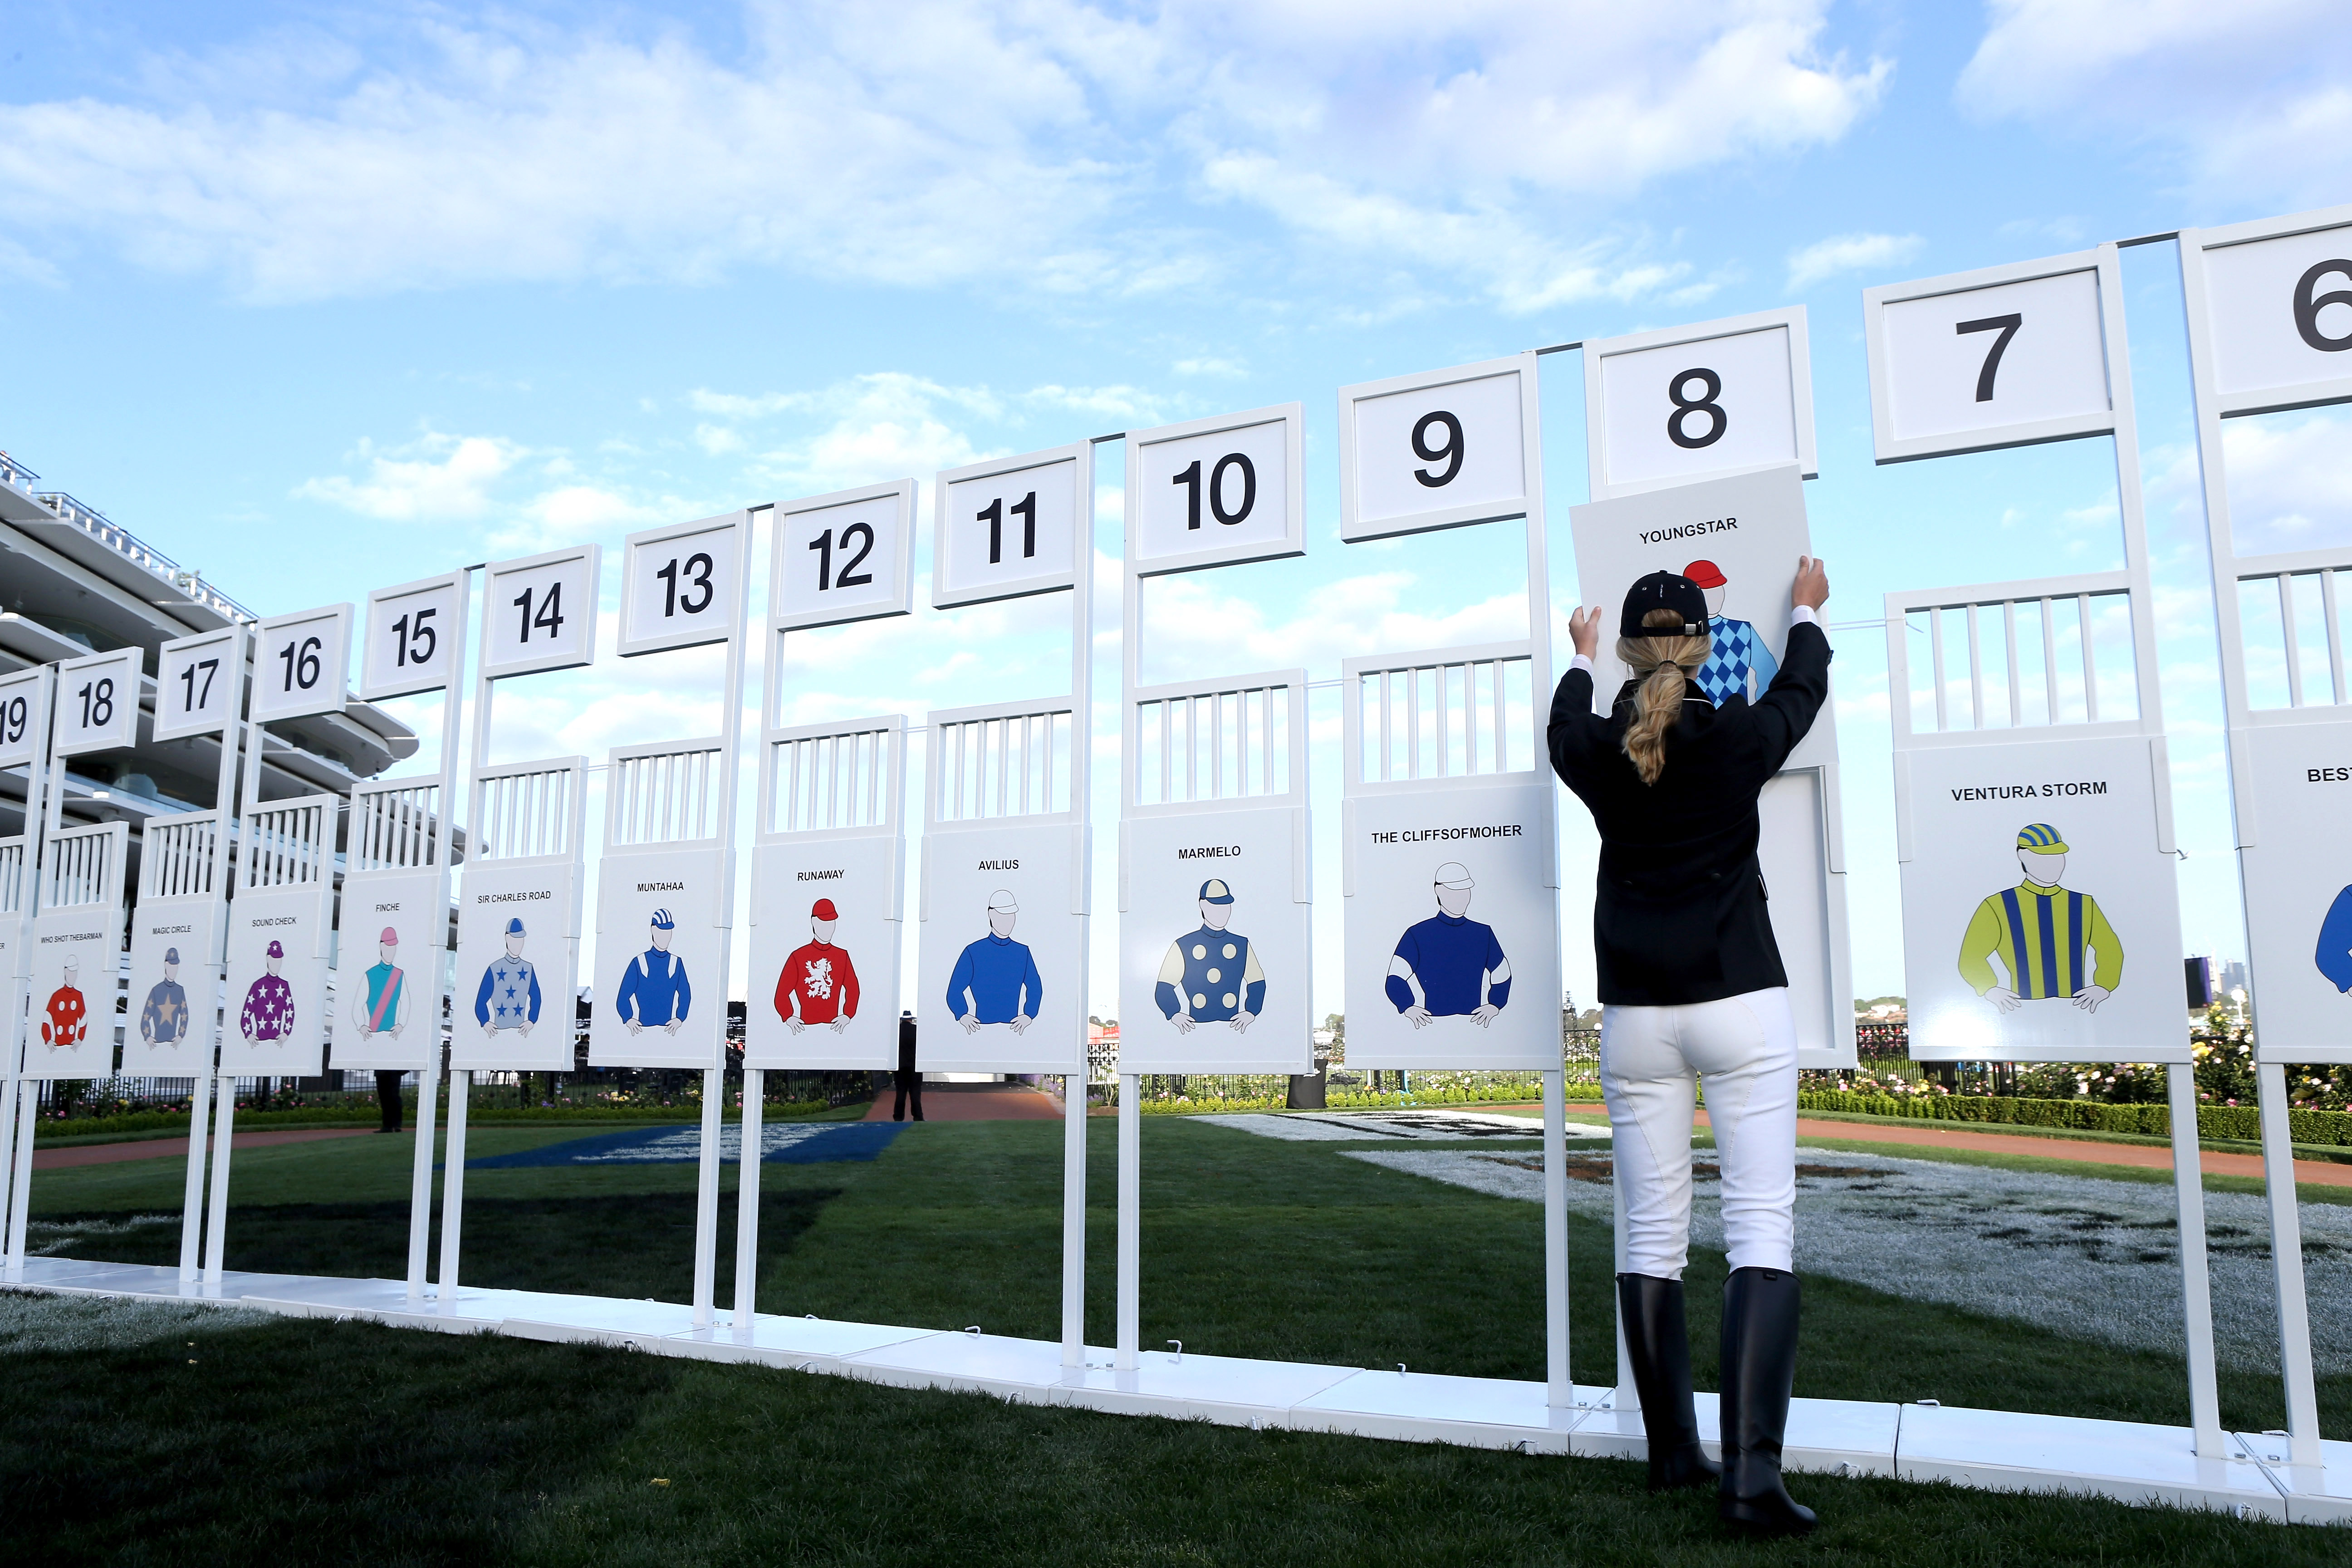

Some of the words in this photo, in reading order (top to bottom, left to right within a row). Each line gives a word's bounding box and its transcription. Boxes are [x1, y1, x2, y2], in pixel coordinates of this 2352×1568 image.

[2293, 259, 2352, 352] 6
[1956, 313, 2022, 402] 7
[1668, 368, 1727, 449] 8
[1412, 411, 1464, 487] 9
[1173, 453, 1256, 530] 10
[977, 491, 1035, 564] 11
[1640, 518, 1738, 544] YOUNGSTAR
[809, 523, 874, 591] 12
[657, 553, 713, 617] 13
[392, 608, 436, 666] 15
[514, 582, 564, 643] 14
[181, 659, 219, 711] 17
[280, 637, 321, 691] 16
[0, 697, 26, 745] 19
[79, 678, 113, 728] 18
[1951, 786, 2037, 801] VENTURA
[2043, 782, 2107, 796] STORM
[2308, 768, 2352, 782] BES
[1179, 846, 1240, 859] MARMELO
[1372, 832, 1397, 843] THE
[1403, 825, 1522, 842] CLIFFSOFMOHER
[637, 882, 683, 892] MUNTAHAA
[798, 870, 844, 881] RUNAWAY
[979, 860, 1019, 870] AVILIUS
[376, 903, 399, 911] FINCHE
[492, 893, 526, 902] CHARLES
[529, 891, 550, 900] ROAD
